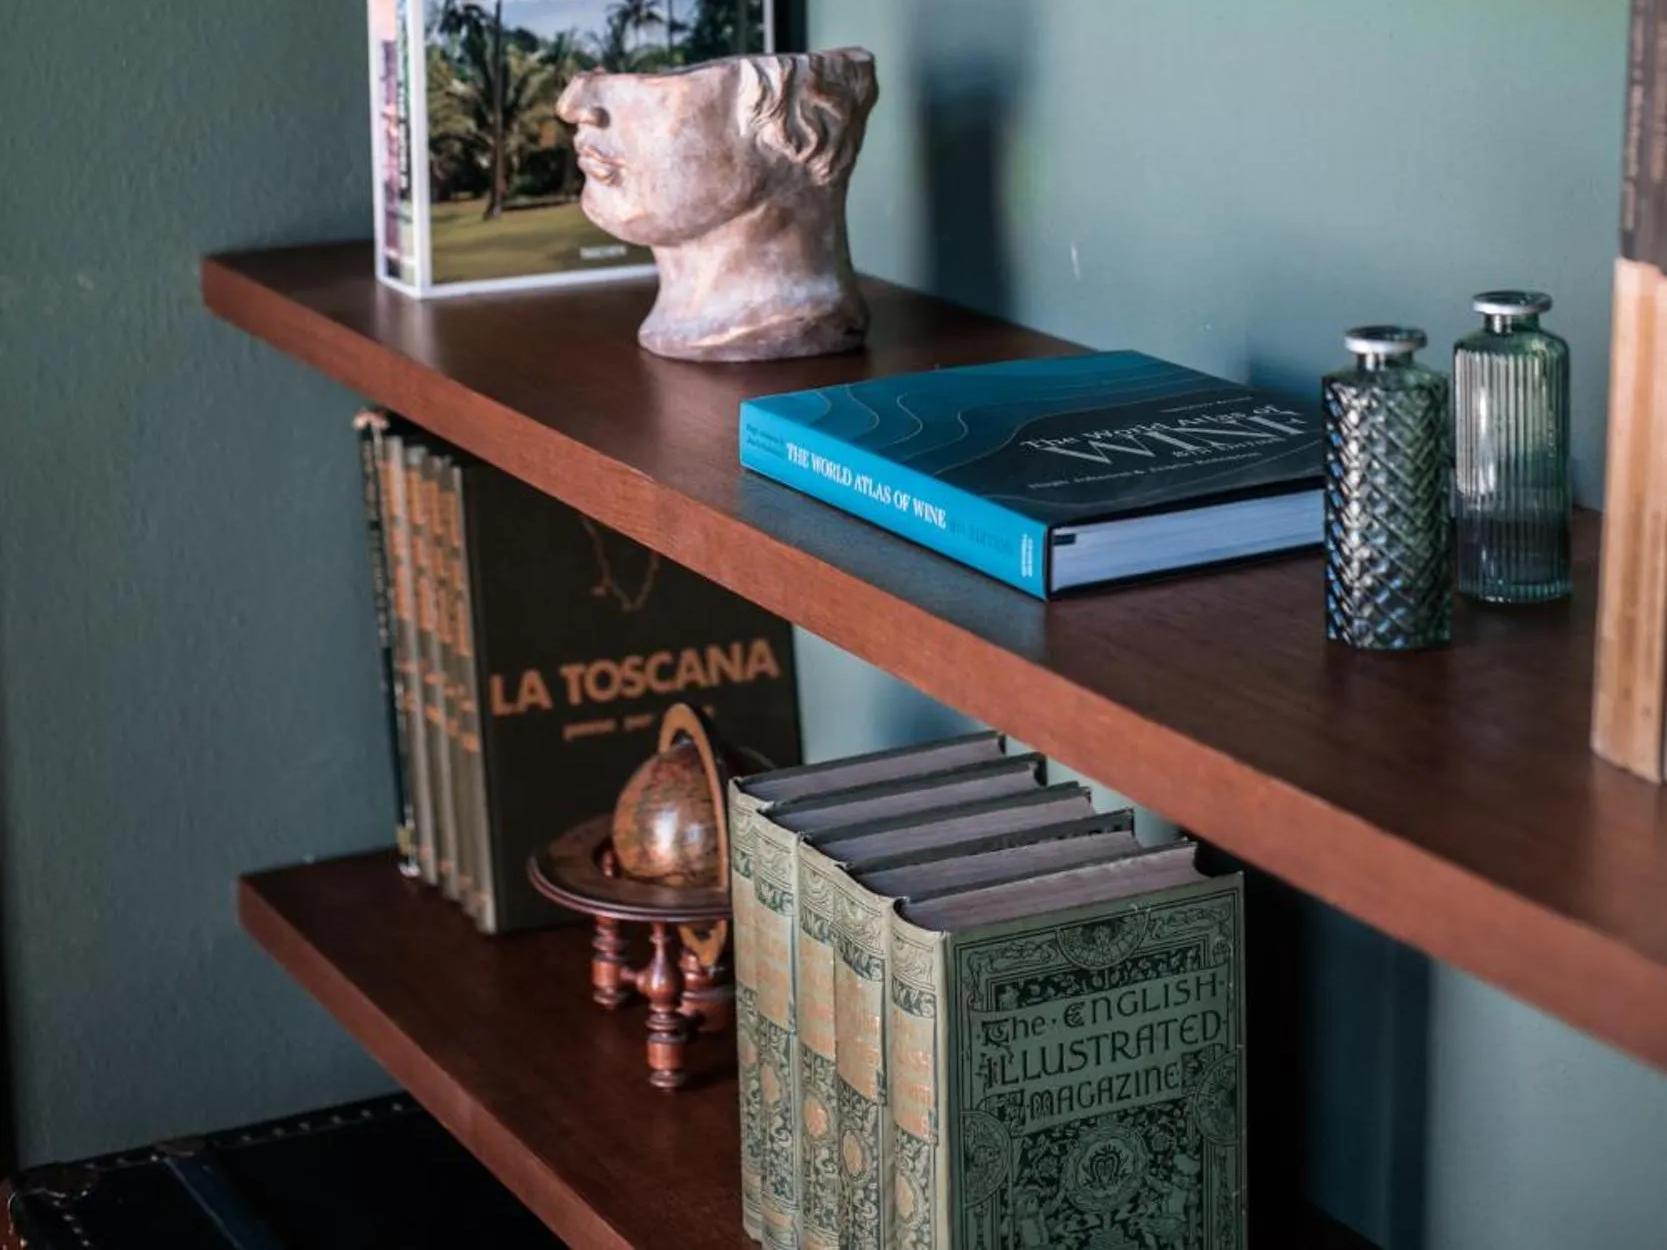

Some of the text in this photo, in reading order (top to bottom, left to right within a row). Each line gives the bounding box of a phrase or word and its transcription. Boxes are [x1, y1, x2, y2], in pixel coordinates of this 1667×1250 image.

[785, 441, 809, 469] THE
[810, 449, 853, 489] WORLD
[854, 469, 892, 505] ATLAS
[893, 489, 910, 513] OF
[912, 497, 947, 531] WINE
[488, 637, 780, 717] LA TOSCANA
[977, 1009, 1223, 1090] ILLUSTRATED
[1029, 1061, 1183, 1122] MAGAZINE
